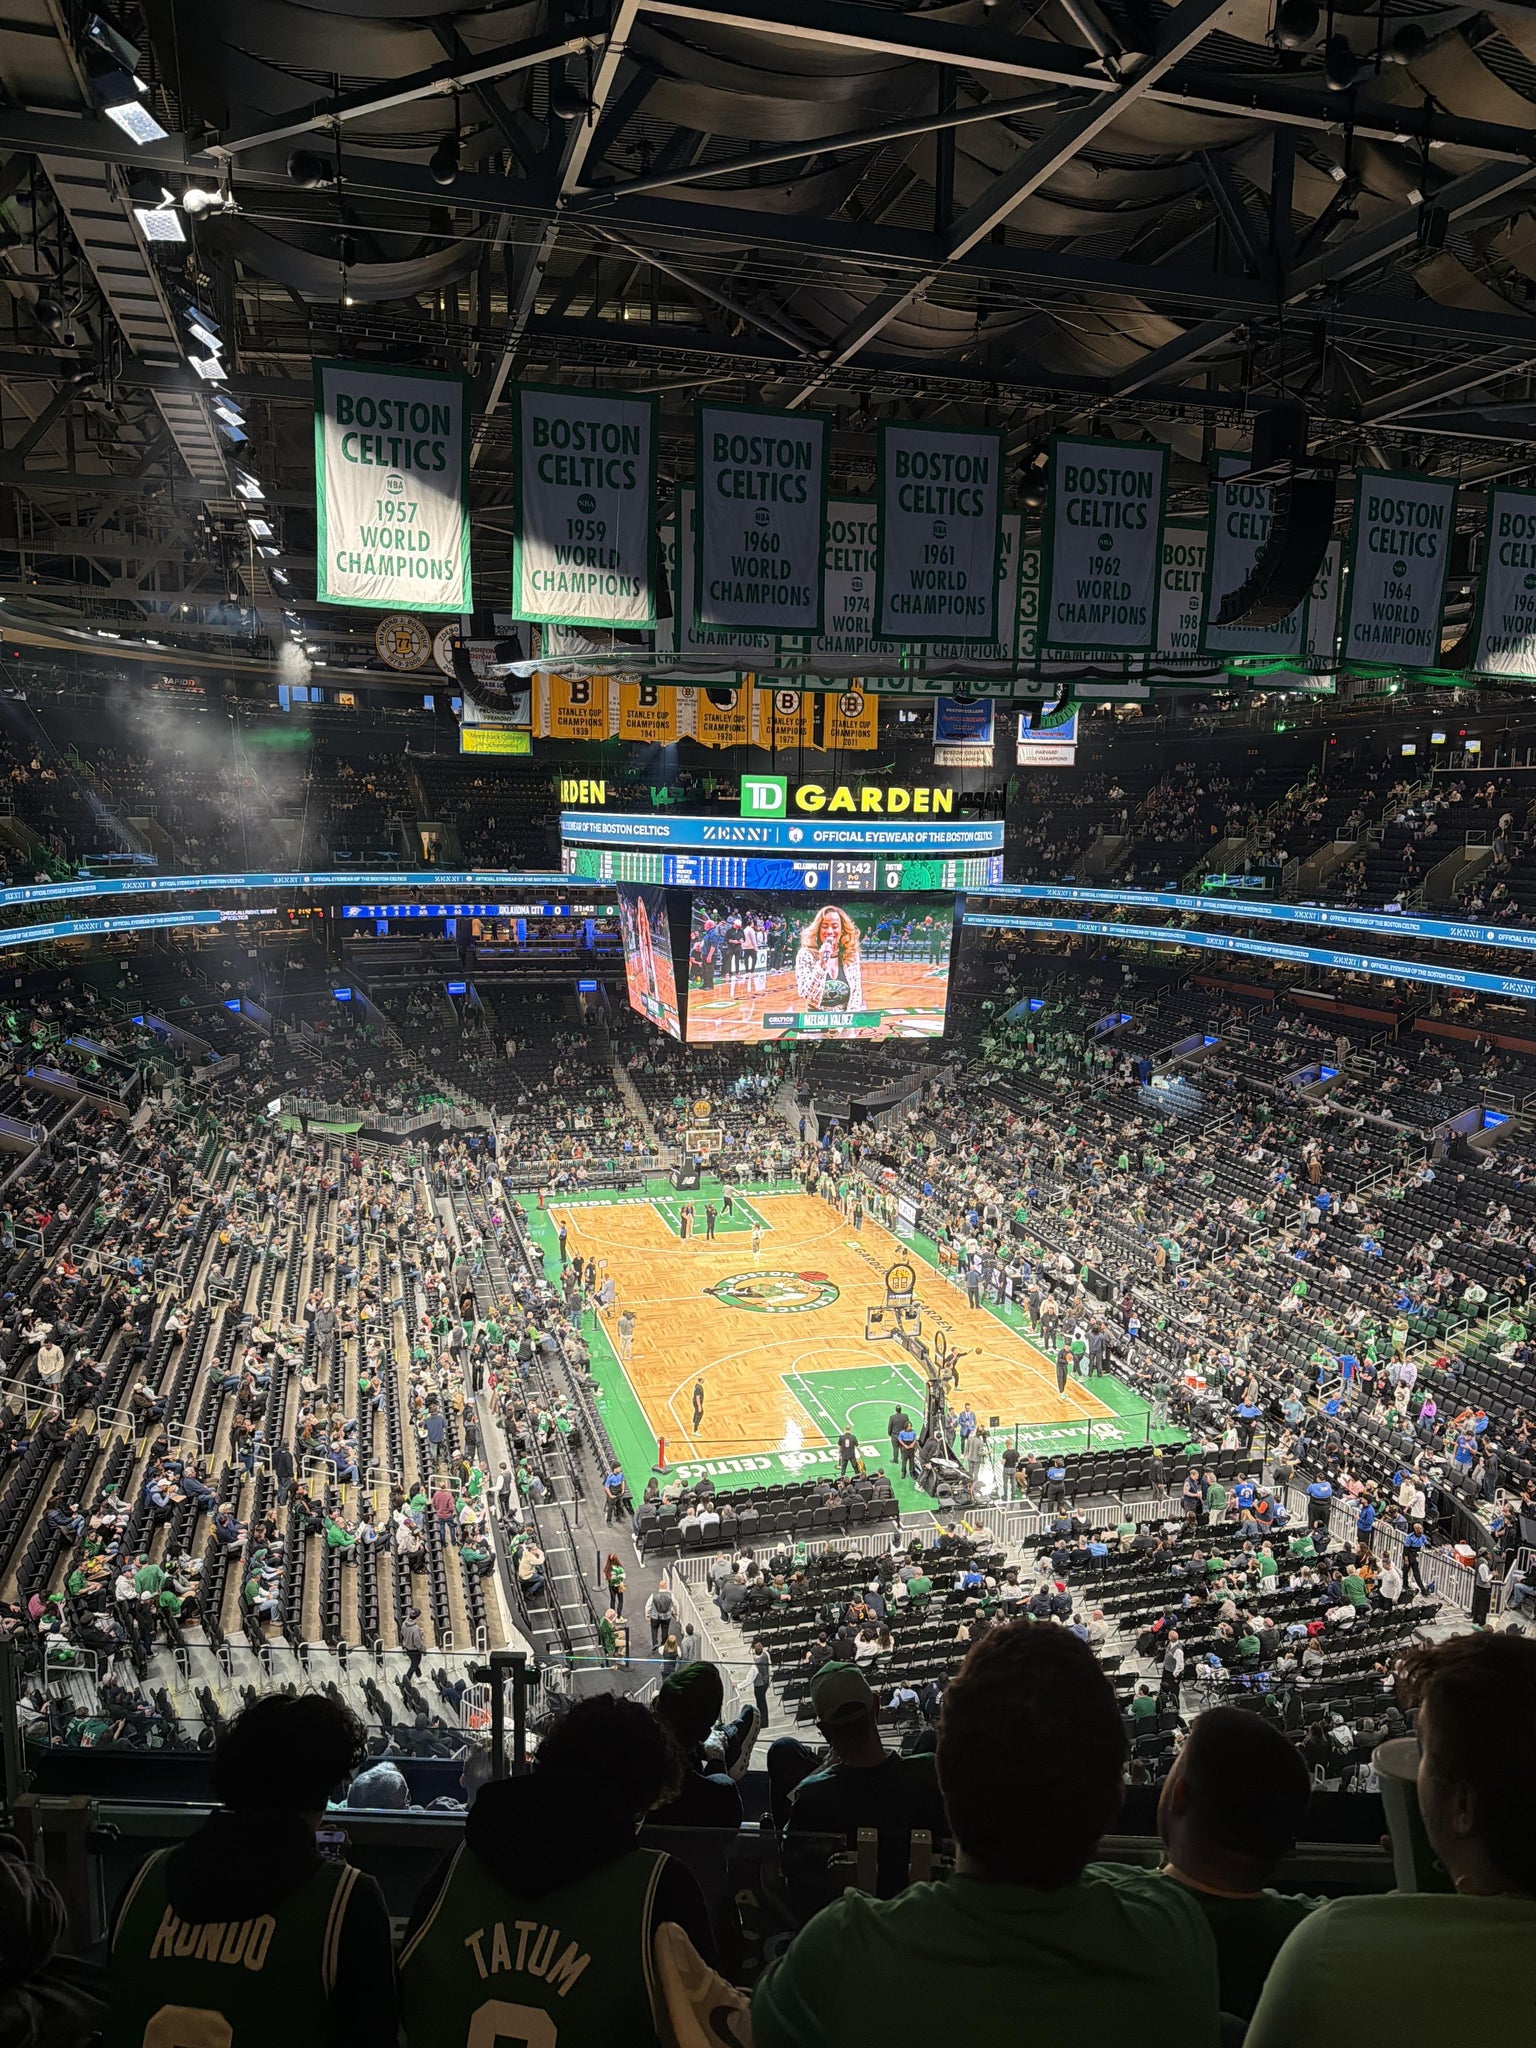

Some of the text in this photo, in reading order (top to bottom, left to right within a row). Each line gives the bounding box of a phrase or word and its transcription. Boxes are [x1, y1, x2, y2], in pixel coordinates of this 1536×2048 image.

[336, 393, 450, 436] BOSTON
[532, 416, 640, 455] BOSTON
[341, 431, 446, 472] CELTICS
[713, 433, 812, 471] BOSTON
[538, 453, 636, 490] CELTICS
[895, 450, 989, 485] BOSTON
[387, 479, 403, 490] NBA
[717, 468, 807, 504] CELTICS
[1064, 465, 1153, 499] BOSTON
[578, 498, 596, 509] NBA
[898, 484, 984, 517] CELTICS
[1225, 484, 1274, 511] BOST
[376, 499, 418, 523] 1957
[1066, 498, 1147, 530] CELTICS
[1368, 496, 1444, 530] BOSTON
[567, 518, 606, 542] 1959
[824, 520, 877, 546] BOSTO
[1227, 511, 1271, 541] CELT
[360, 525, 430, 552] WORLD
[744, 531, 780, 553] 1960
[1368, 526, 1437, 559] CELTICS
[555, 544, 621, 570] WORLD
[824, 547, 877, 572] CELTIC
[924, 544, 954, 566] 1961
[1163, 543, 1206, 567] BOST
[336, 551, 454, 581] CHAMPIONS
[731, 556, 791, 580] WORLD
[1088, 556, 1121, 577] 1962
[531, 570, 640, 598] CHAMPIONS
[910, 570, 967, 591] WORLD
[1076, 579, 1131, 601] WORLD
[1164, 569, 1206, 592] CELT
[1384, 581, 1412, 601] 1964
[710, 580, 810, 607] CHAMPIONS
[843, 595, 870, 613] 1974
[1514, 594, 1536, 612] 196
[890, 593, 986, 616] CHAMPIONS
[1057, 602, 1147, 626] CHAMPIONS
[1373, 602, 1420, 624] WORLD
[378, 618, 399, 646] RAYMOND
[833, 616, 869, 633] WORL
[1179, 614, 1198, 630] 198
[397, 637, 411, 648] 77
[688, 631, 770, 649] CHAMPIONS
[1171, 632, 1199, 648] WOR
[1354, 623, 1432, 647] CHAMPIONS
[933, 643, 1008, 658] CHAMPIONS
[571, 682, 590, 703] B
[782, 693, 794, 709] B
[558, 708, 602, 717] STANLEY CUP
[627, 710, 669, 719] STANLEY CUP
[846, 697, 857, 711] B
[558, 717, 603, 727] CHAMPIONS
[626, 719, 670, 729] CHAMPIONS
[703, 723, 746, 732] CHAMPIONS
[704, 714, 746, 723] STANLEY CUP
[832, 720, 871, 729] STANLEY CUP
[572, 727, 589, 736] 1939
[641, 730, 656, 738] 1941
[717, 732, 733, 741] 1970
[831, 729, 871, 738] CHAMPIONS
[561, 780, 606, 805] RDEN
[745, 782, 953, 813] TD GARDEN
[590, 823, 602, 833] THE
[602, 823, 633, 834] BOSTON
[633, 825, 670, 836] CELTICS
[703, 826, 993, 843] ZENNI OFFICIAL EYEWEAR OF THE BOSTON CELTICS
[836, 863, 871, 874] 21:42
[804, 871, 818, 888] 0
[886, 871, 899, 888] 0
[499, 906, 545, 915] OKLAHOMA CITY
[554, 906, 561, 915] 0
[606, 906, 613, 915] 0
[1451, 928, 1522, 943] ZENNI OFFICIAL
[1503, 982, 1535, 993] ZENNI
[549, 1196, 674, 1208] BOSTON CELTICS
[725, 1271, 795, 1285] BOSTON
[766, 1296, 834, 1312] CELTICS
[675, 1454, 772, 1479] CELTICS
[464, 1919, 592, 1998] TATUM
